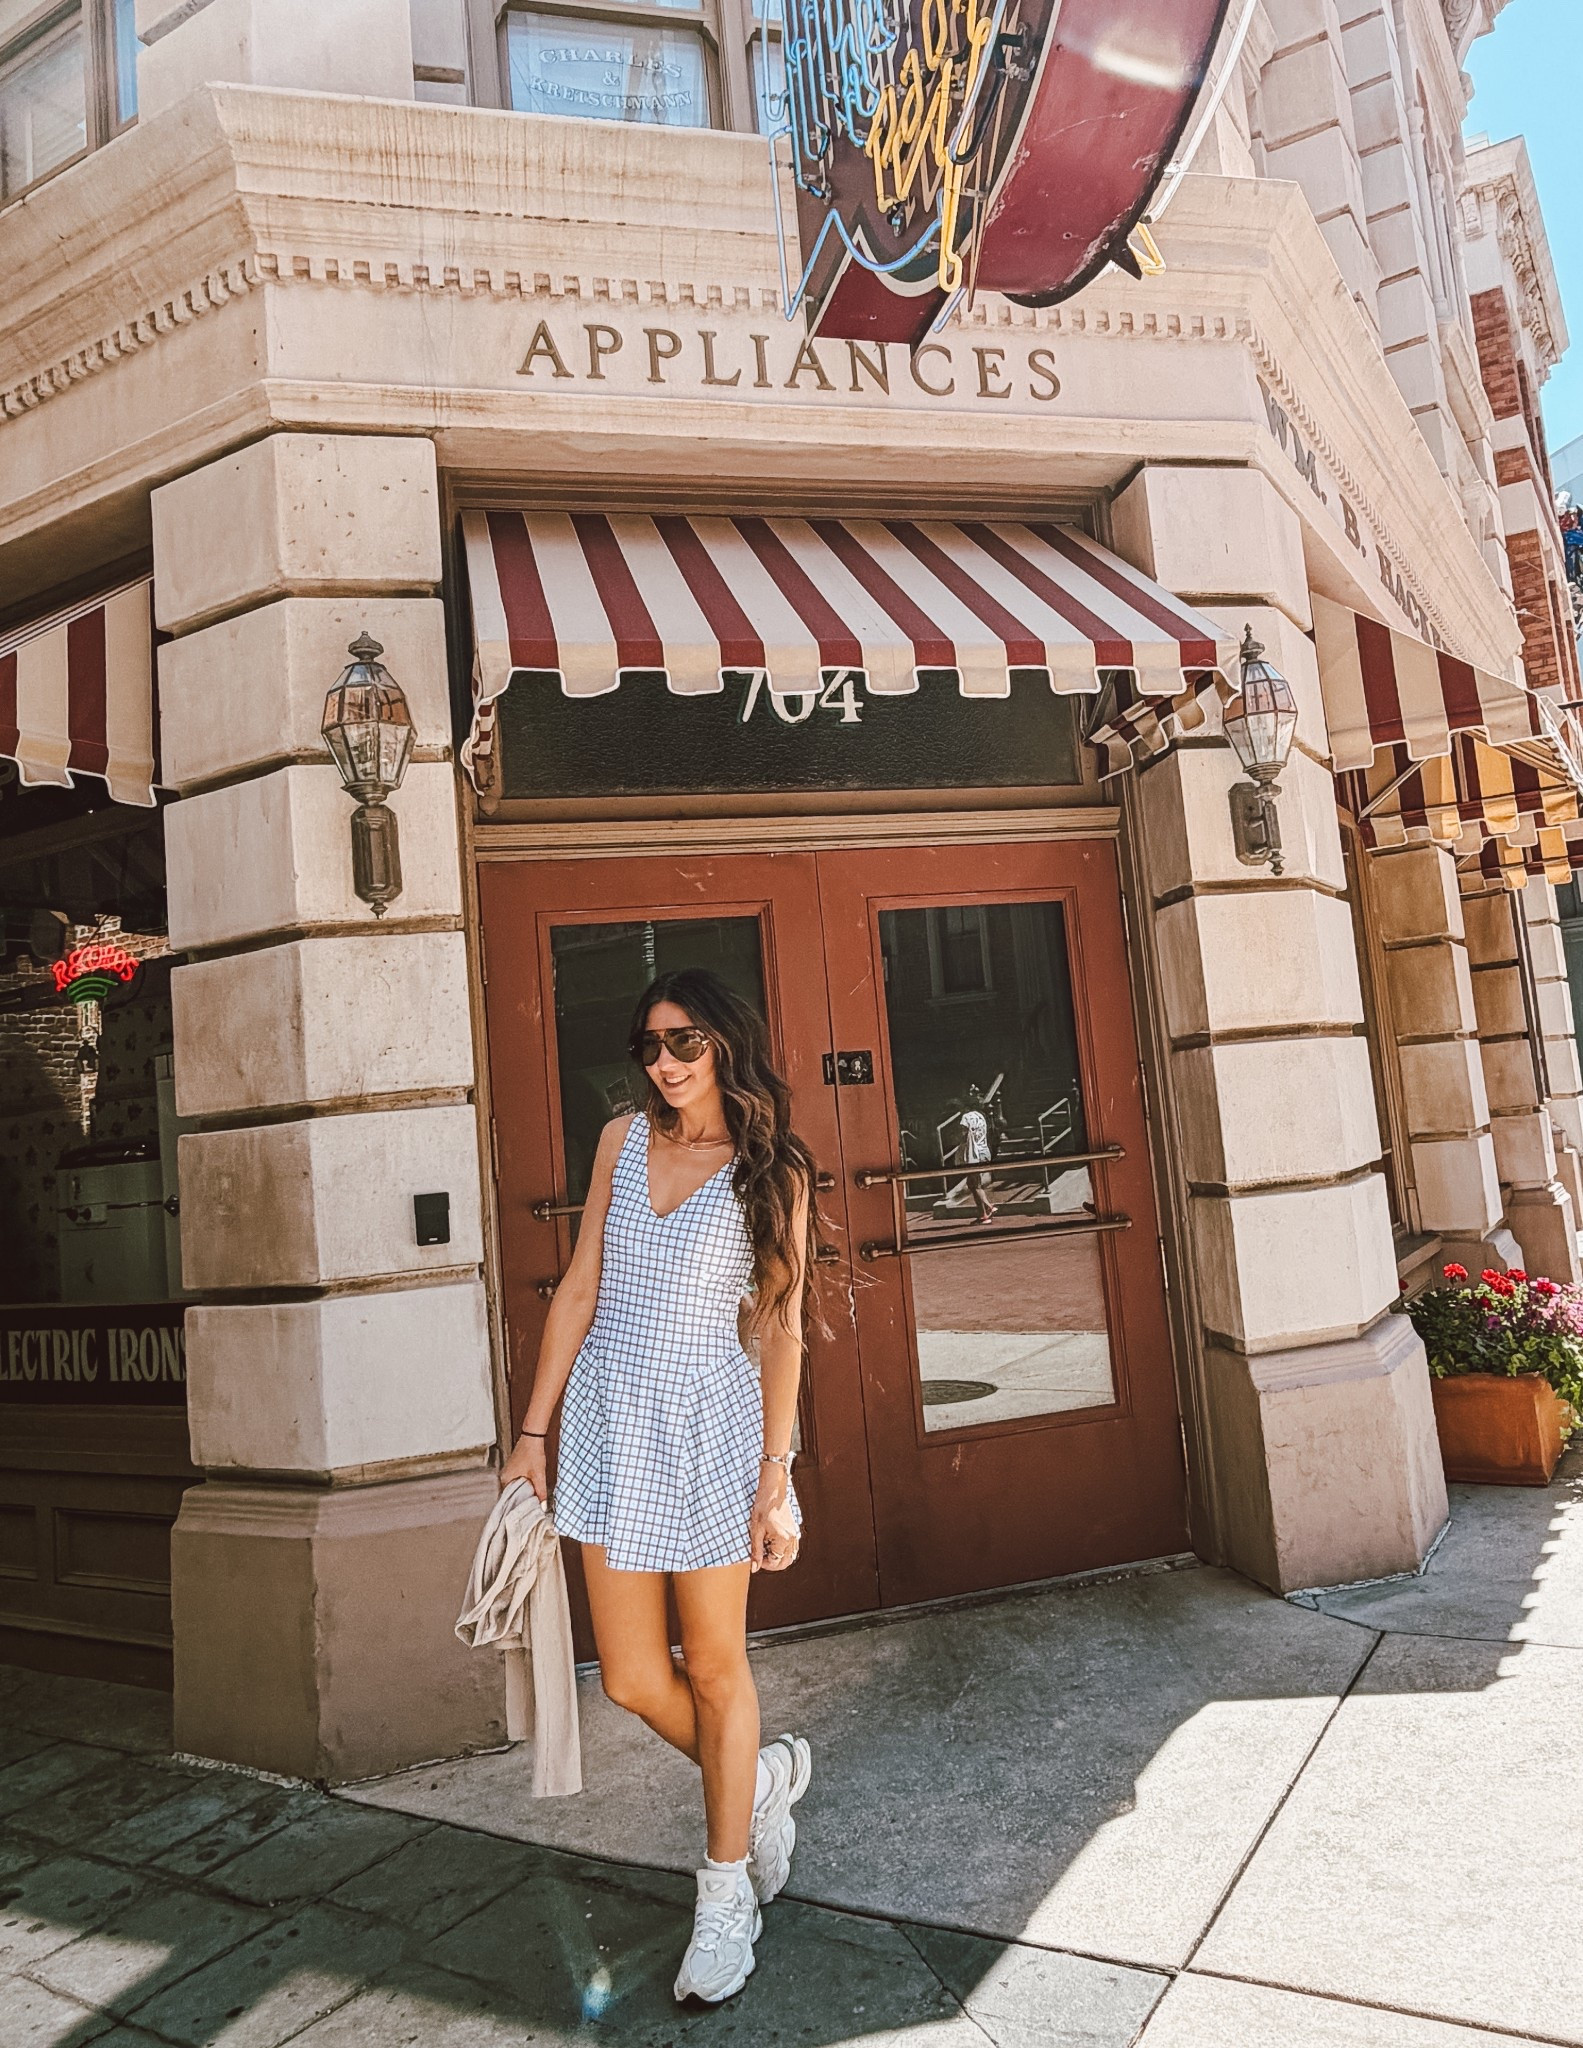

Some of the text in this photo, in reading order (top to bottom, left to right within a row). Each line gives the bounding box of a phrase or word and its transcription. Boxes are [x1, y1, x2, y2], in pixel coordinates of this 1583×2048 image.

[538, 48, 683, 79] CHARLES
[602, 70, 621, 87] &
[530, 74, 692, 111] KRETSCHMANN
[515, 319, 1062, 401] APPLIANCES
[0, 1328, 99, 1383] ECTRIC
